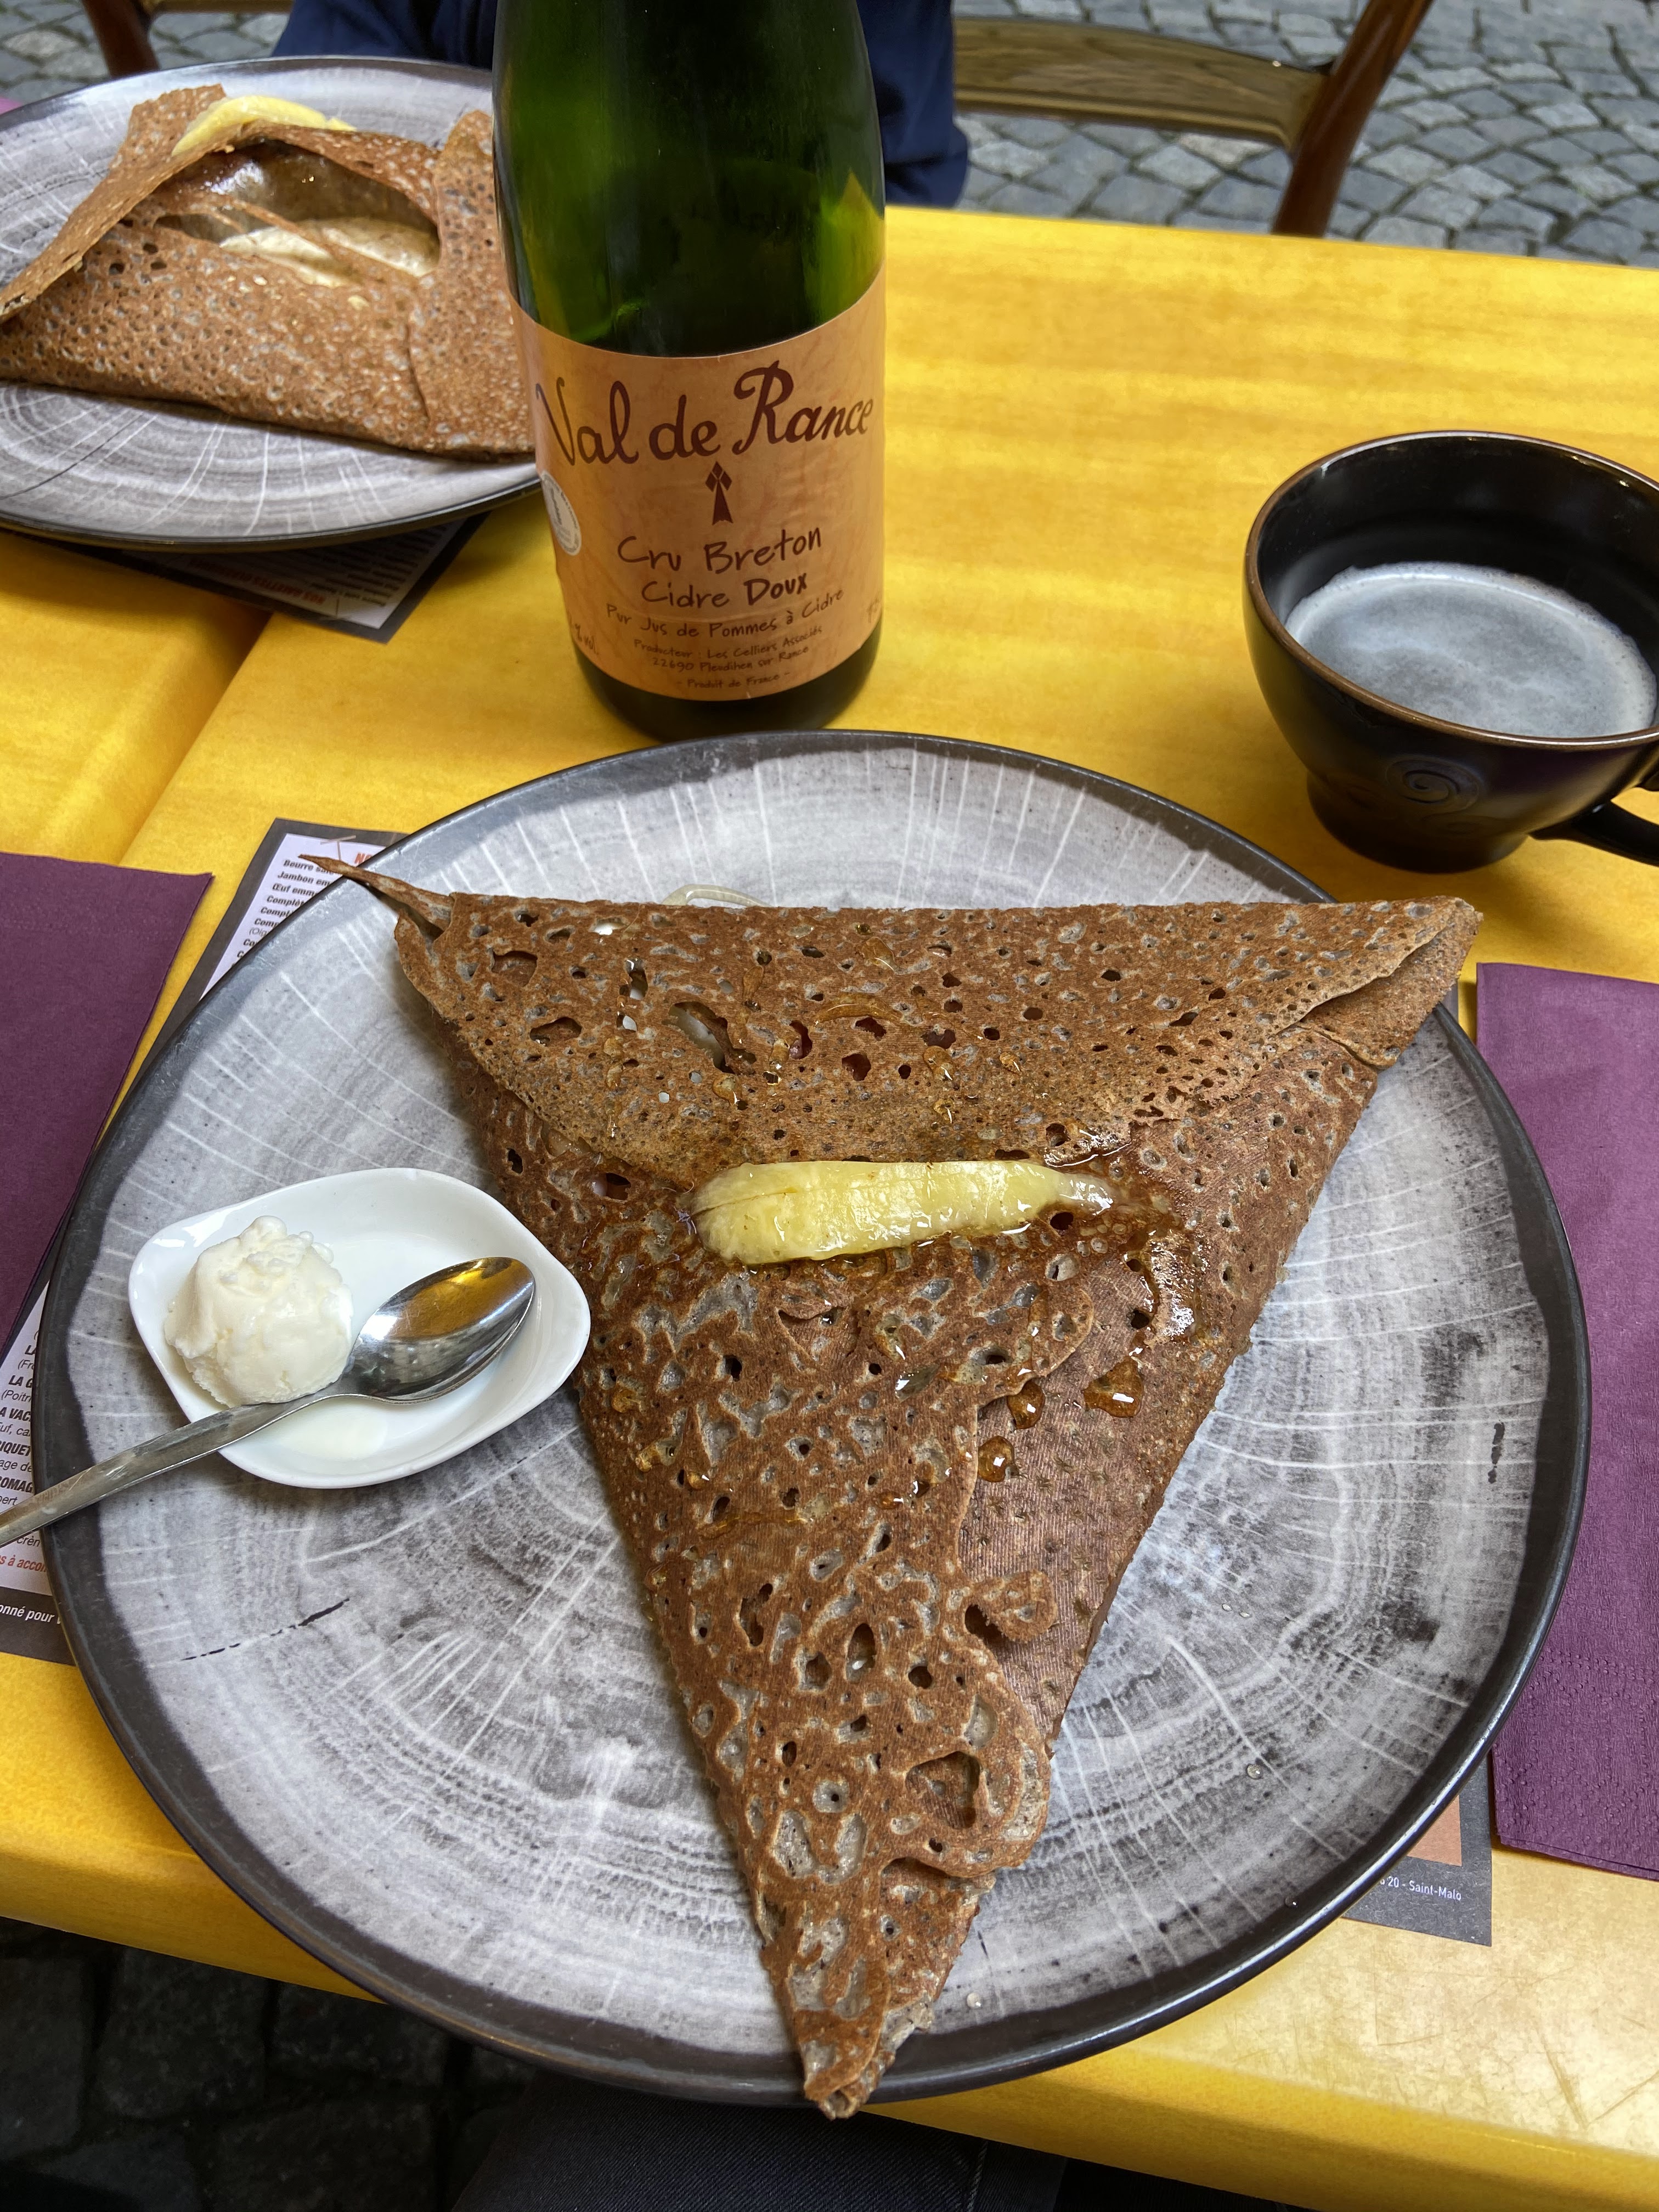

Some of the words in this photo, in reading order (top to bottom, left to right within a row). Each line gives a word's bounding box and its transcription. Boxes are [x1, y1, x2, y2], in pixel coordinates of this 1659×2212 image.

[535, 376, 639, 466] Val
[649, 394, 721, 461] de
[732, 360, 873, 455] Rance
[618, 536, 681, 571] Cru
[703, 527, 821, 574] Breton
[642, 581, 730, 608] Cidre
[743, 573, 807, 606] Doux
[607, 603, 632, 624] Pur
[641, 617, 667, 635] Jus
[676, 623, 699, 637] de
[709, 618, 777, 637] Pommes
[786, 611, 794, 625] à
[802, 590, 844, 618] Cidre
[634, 639, 693, 658] Producteur
[708, 649, 727, 658] Les
[733, 643, 777, 657] Celliers
[782, 626, 822, 647] Associés
[653, 659, 694, 672] 22690
[758, 658, 773, 668] sur
[778, 647, 809, 662] Rance
[687, 679, 724, 688] Produit
[746, 674, 780, 686] France
[284, 860, 313, 871] Beurre
[277, 872, 314, 884] Jambon
[8, 1375, 24, 1386] LA
[25, 1610, 55, 1623] pour
[1409, 1880, 1462, 1901] Saint-Malo
